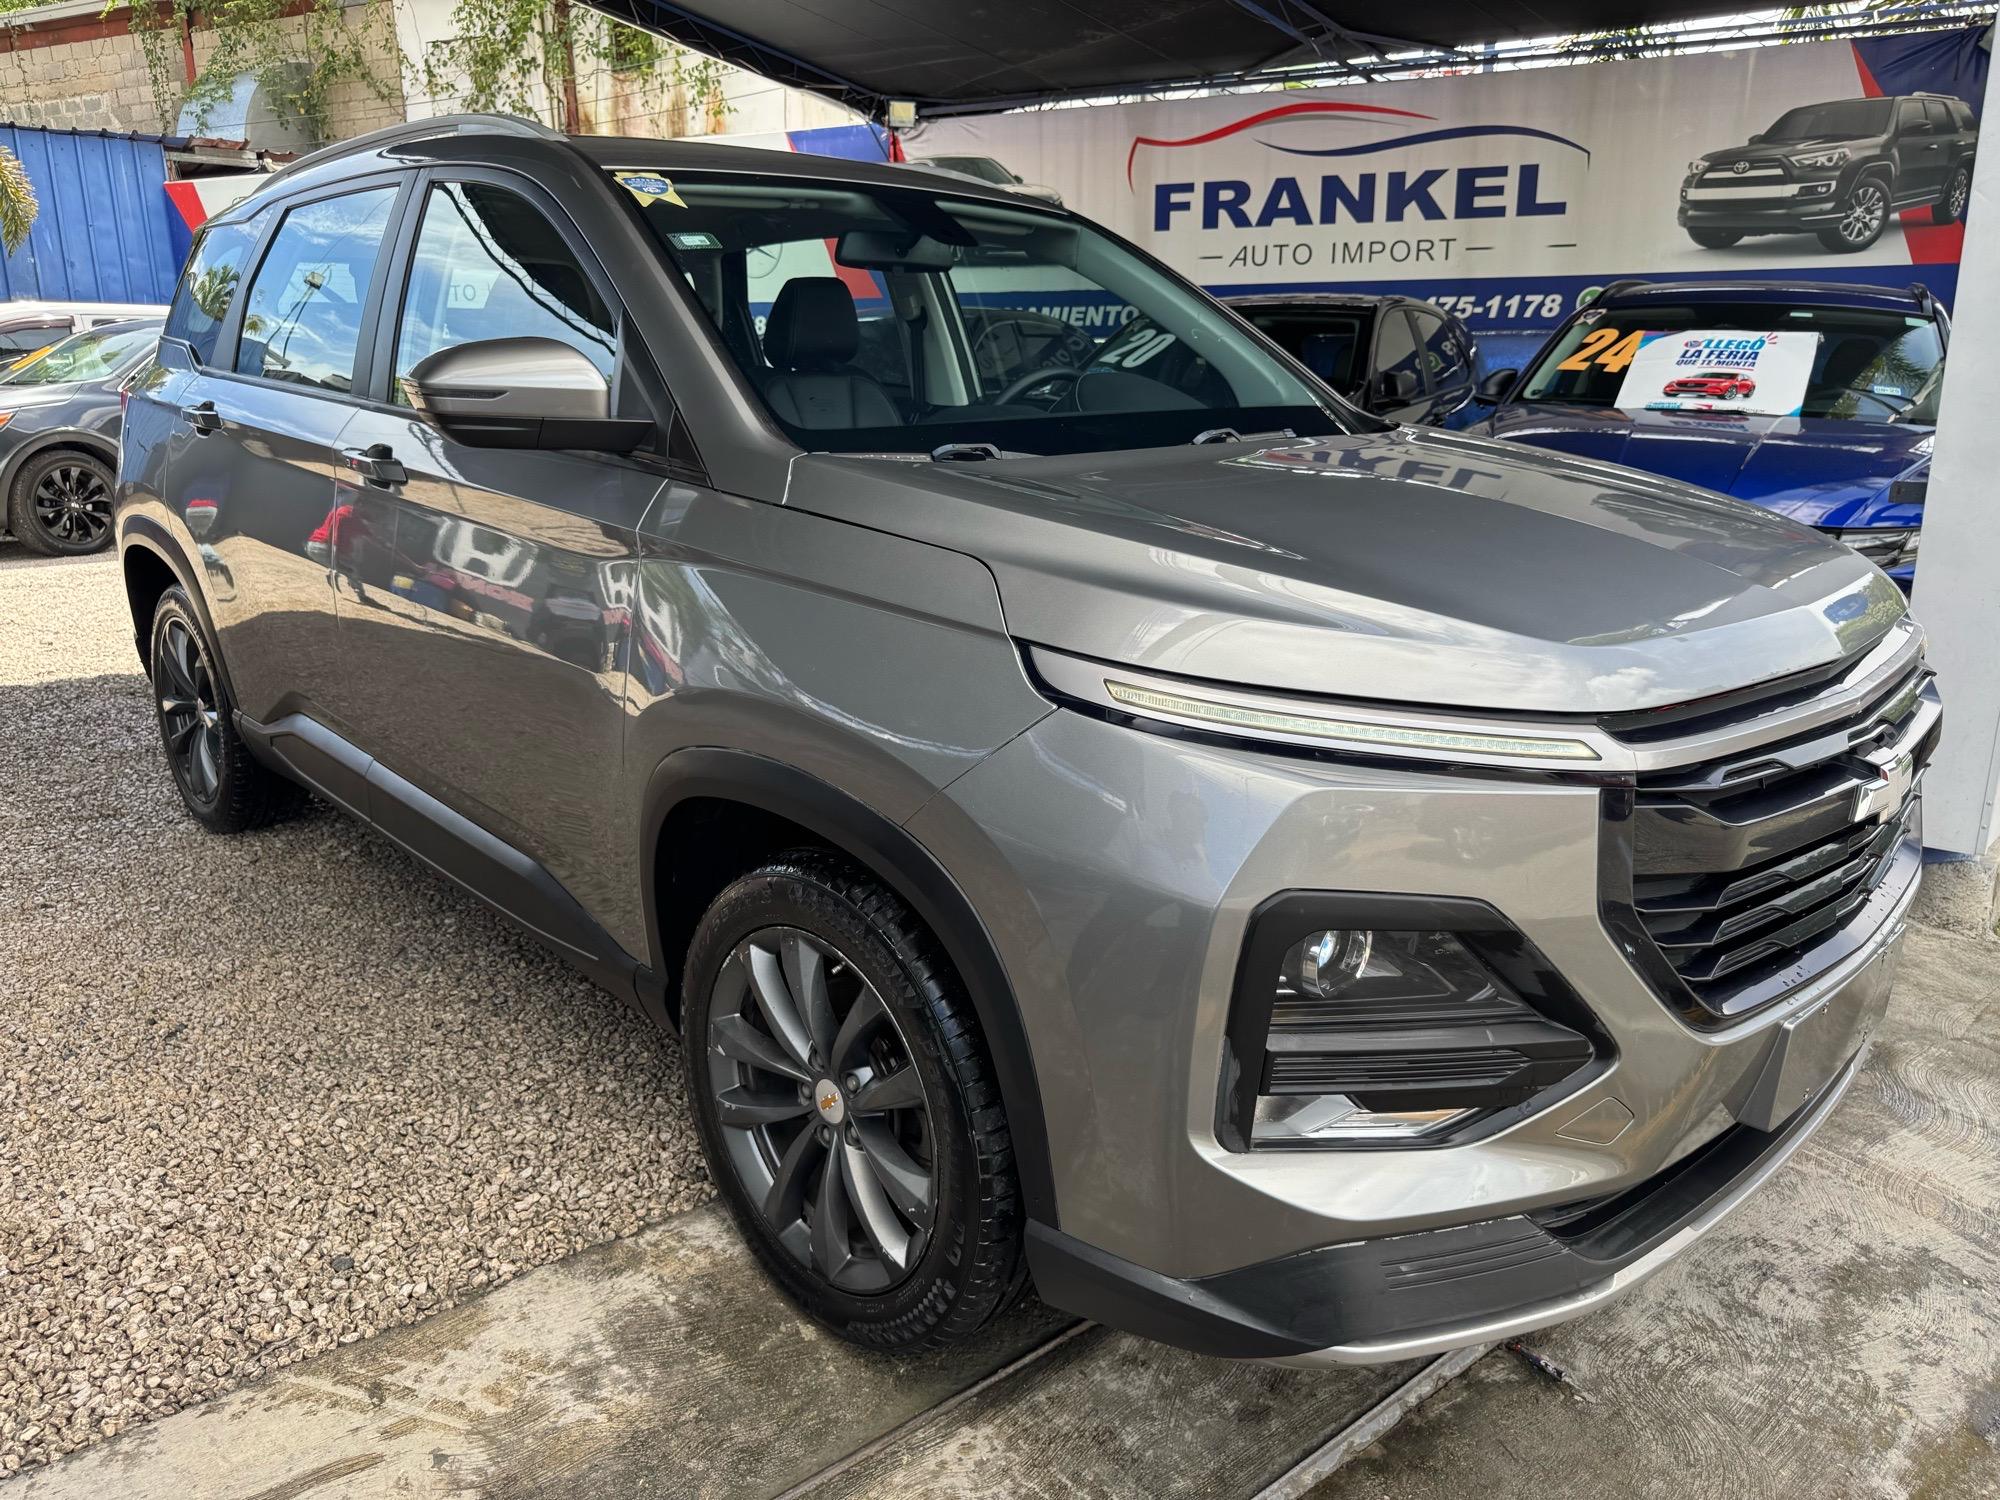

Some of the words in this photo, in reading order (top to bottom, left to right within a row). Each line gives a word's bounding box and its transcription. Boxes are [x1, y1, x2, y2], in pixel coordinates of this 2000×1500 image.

[1154, 164, 1567, 232] FRANKEL
[1229, 243, 1313, 268] AUTO
[1331, 238, 1457, 264] IMPORT
[1027, 305, 1140, 327] MIENTO
[1099, 328, 1176, 368] 20
[1556, 328, 1646, 373] 24
[1680, 349, 1703, 359] LA
[1705, 349, 1760, 361] FERIA
[1714, 359, 1757, 367] MONTA
